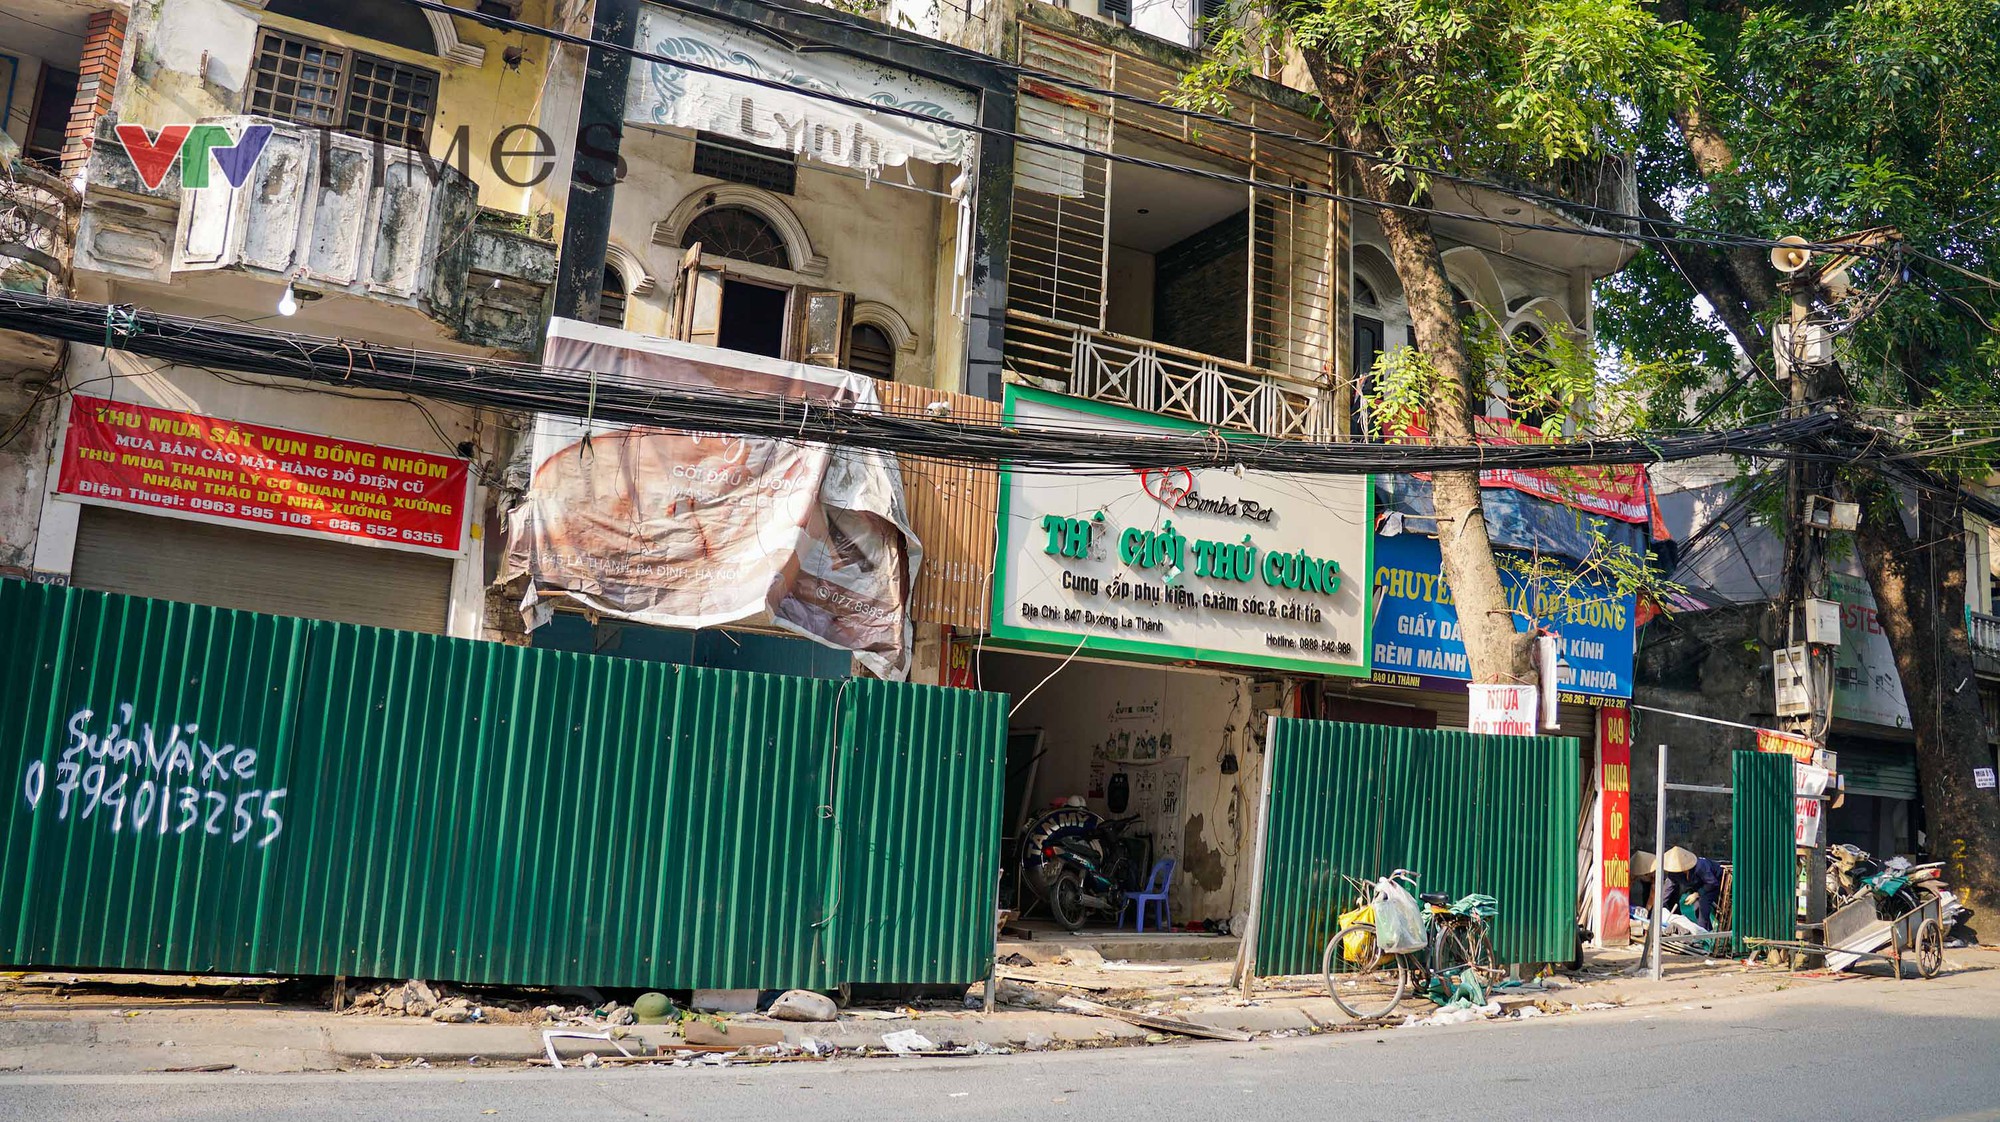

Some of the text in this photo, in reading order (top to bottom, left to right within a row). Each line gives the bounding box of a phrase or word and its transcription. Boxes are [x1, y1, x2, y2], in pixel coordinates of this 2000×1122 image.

[96, 408, 449, 480] THU MUA SẮT VỤN ĐỒNG NHÔM
[115, 434, 425, 494] MUA BÁN CÁC MẶT HÀNG ĐỒ ĐIỆN CŨ
[78, 447, 453, 516] THU MUA THANH LÝ CƠ QUAN NHÀ XƯỞNG
[142, 473, 198, 493] NHẬN
[203, 481, 252, 499] THÁO
[287, 495, 325, 512] NHÀ
[330, 501, 393, 522] XƯỞNG
[1175, 487, 1274, 523] Simba Pet
[79, 480, 122, 498] Điện
[128, 487, 185, 507] Thoại:
[190, 498, 236, 515] 0963
[240, 505, 274, 520] 595
[280, 510, 312, 526] 108
[329, 518, 361, 533] 086
[366, 524, 398, 538] 552
[402, 529, 444, 544] 6355
[566, 554, 584, 567] LA
[636, 563, 654, 575] BA
[1192, 533, 1258, 583] THÚ
[1261, 548, 1342, 595] CƯNG
[1021, 602, 1039, 620] Địa
[1064, 608, 1082, 623] 847
[1121, 614, 1133, 628] La
[1135, 616, 1165, 632] Thành
[1062, 570, 1099, 596] Cung
[1133, 582, 1160, 607] phụ
[1242, 595, 1265, 615] sóc
[1267, 599, 1277, 618] &
[1397, 611, 1437, 638] GIẤY
[1570, 637, 1605, 661] KÍNH
[1372, 671, 1386, 685] 849
[1387, 673, 1397, 686] LA
[1374, 641, 1413, 667] RÈM
[1417, 647, 1467, 673] MÀNH
[1579, 667, 1618, 693] NHỰA
[1607, 716, 1625, 745] 849
[1604, 763, 1629, 799] NHỰA
[1610, 802, 1623, 841] ỐP
[1604, 853, 1629, 889] TƯỜNG
